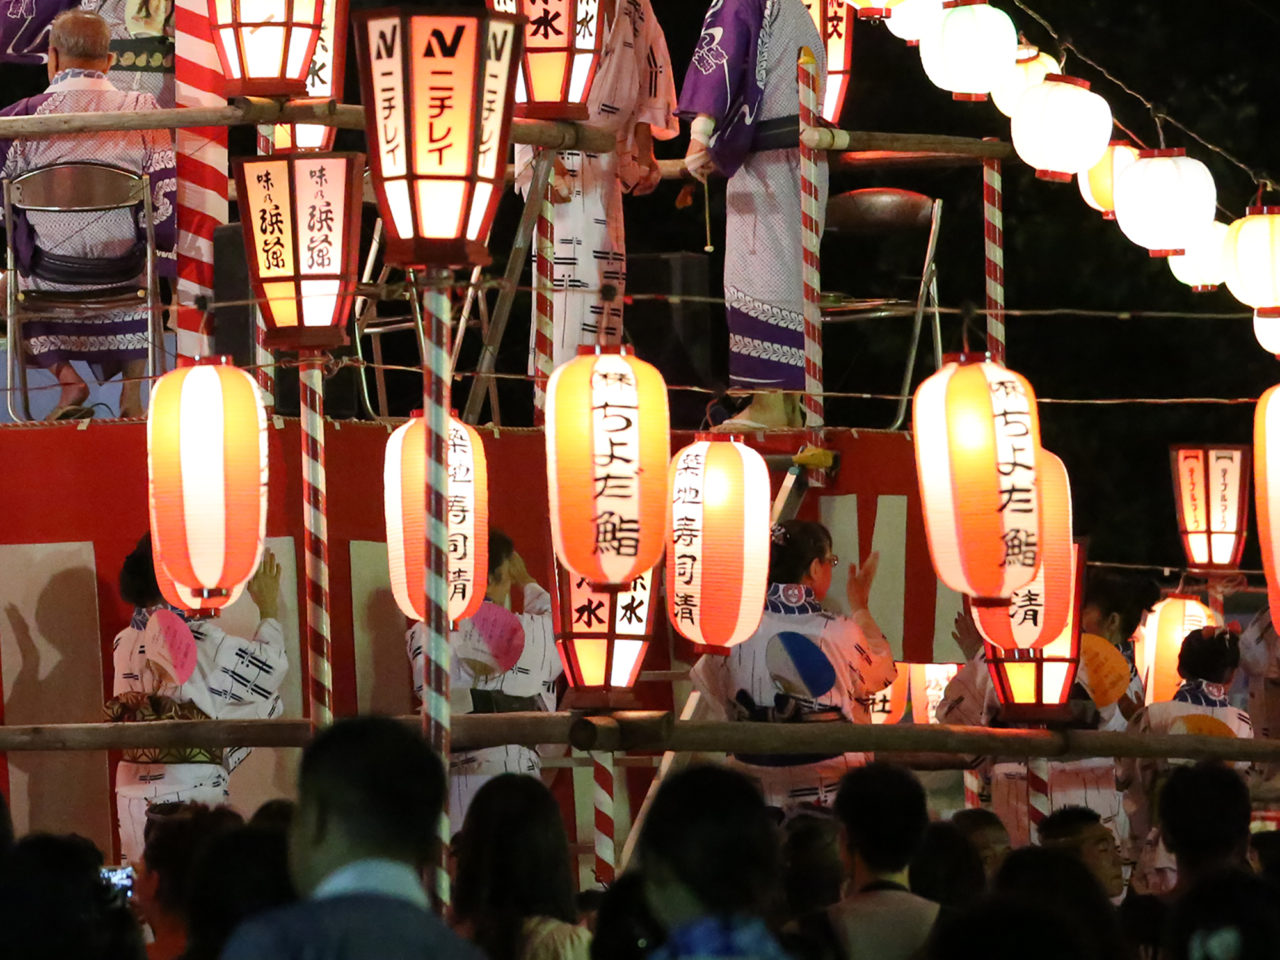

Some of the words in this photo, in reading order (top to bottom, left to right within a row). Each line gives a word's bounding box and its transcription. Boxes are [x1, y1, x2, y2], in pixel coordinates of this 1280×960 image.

[381, 71, 400, 166] ニチレイ
[428, 71, 453, 166] ニチレイ
[478, 72, 499, 168] ニチレイ
[673, 453, 704, 625] 築地寿司清
